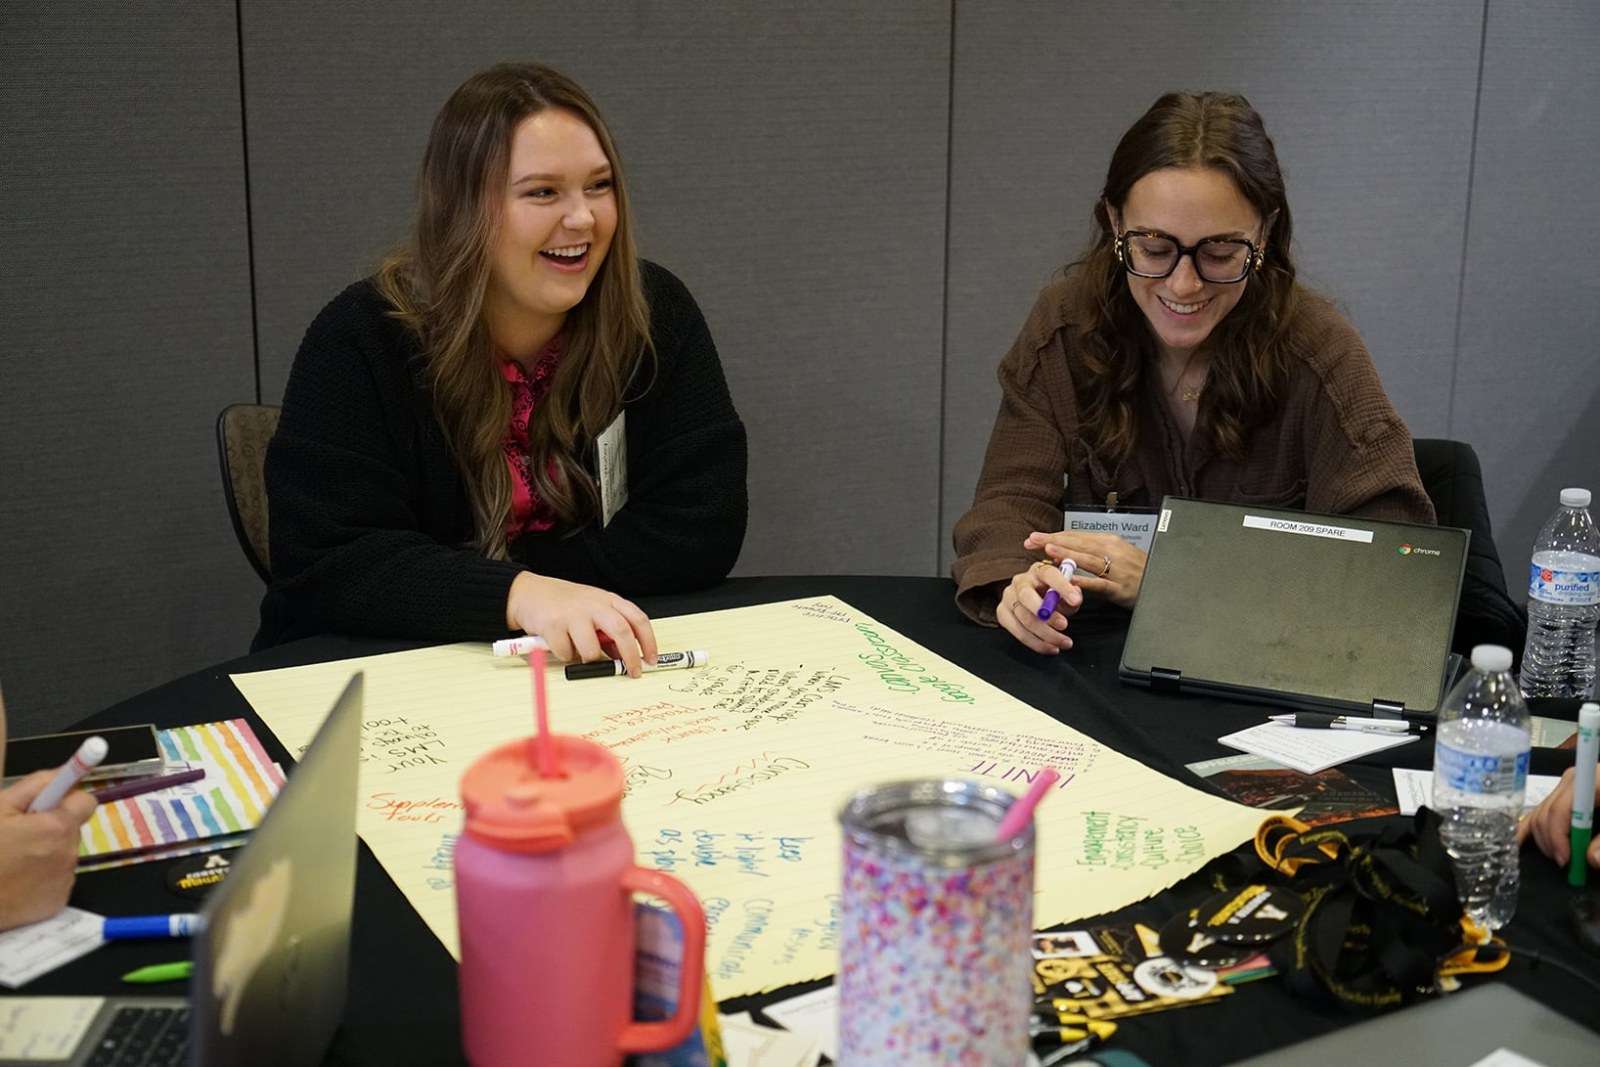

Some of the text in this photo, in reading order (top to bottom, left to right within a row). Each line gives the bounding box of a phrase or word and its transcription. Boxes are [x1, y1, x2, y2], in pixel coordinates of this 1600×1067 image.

[1071, 520, 1149, 532] Elizabeth Ward
[1270, 520, 1346, 537] ROOM 209 SPARE
[1413, 547, 1441, 556] chrome
[1554, 583, 1590, 592] purified
[387, 740, 446, 757] LMS
